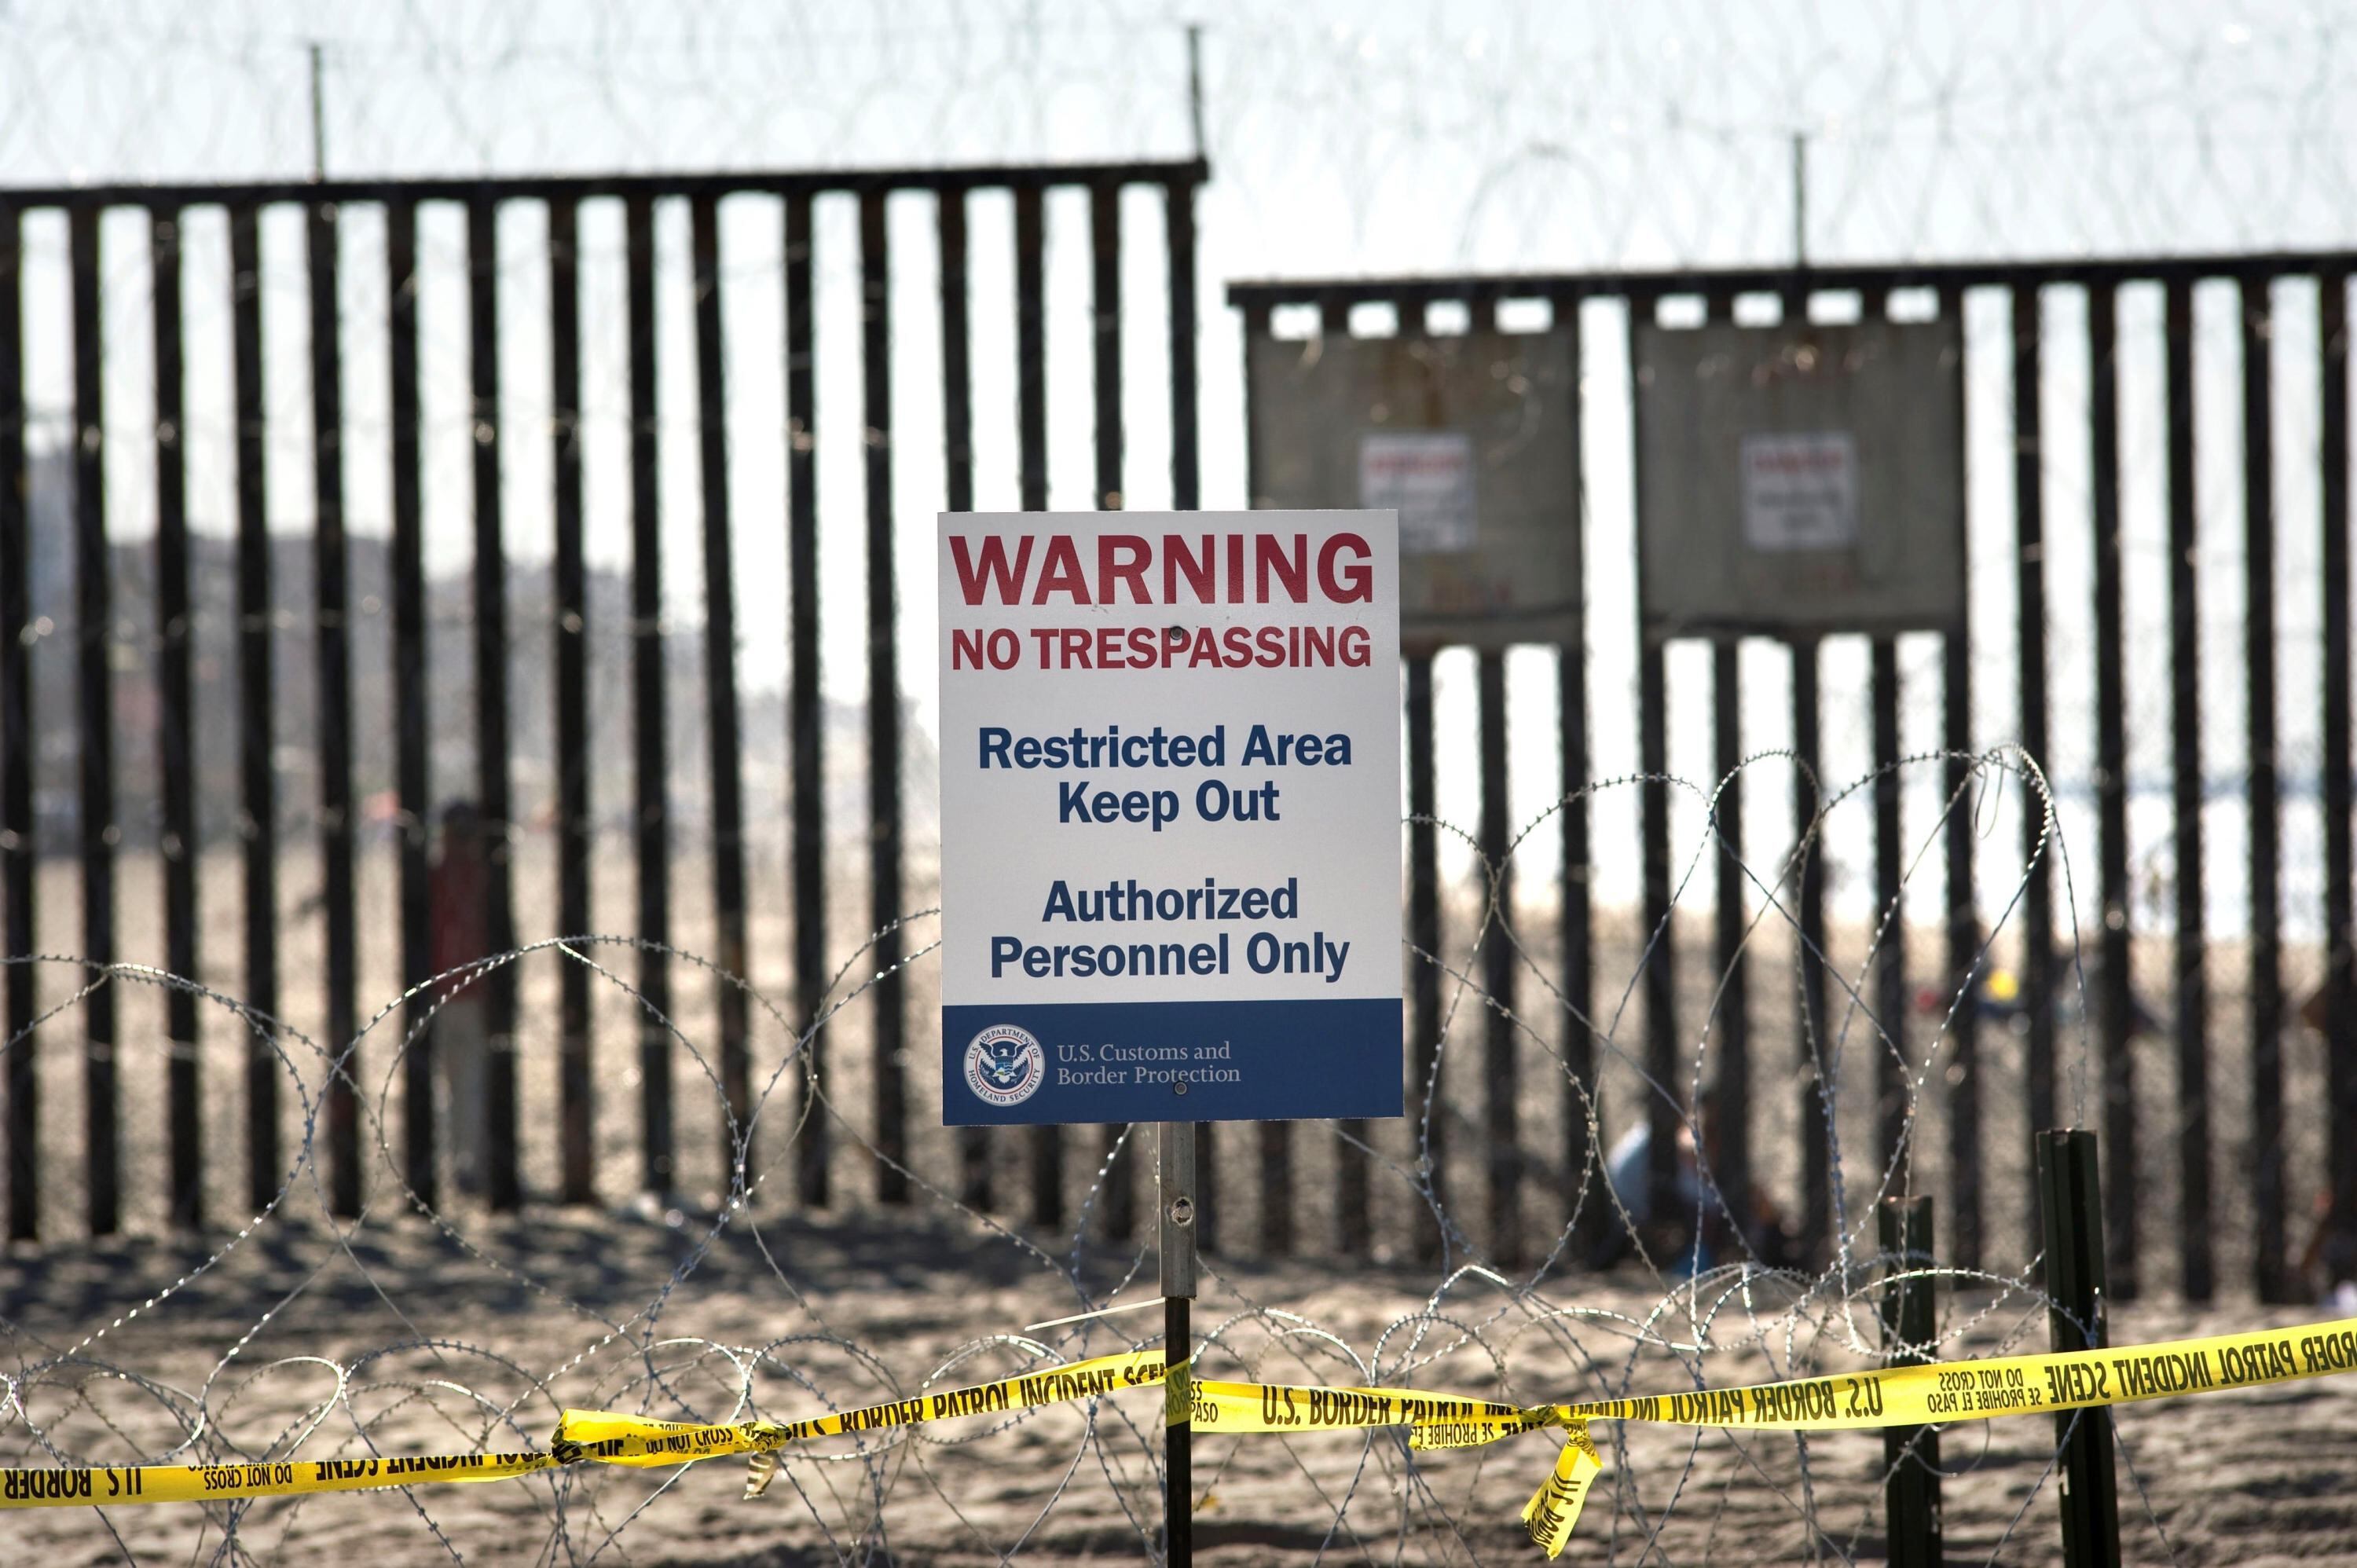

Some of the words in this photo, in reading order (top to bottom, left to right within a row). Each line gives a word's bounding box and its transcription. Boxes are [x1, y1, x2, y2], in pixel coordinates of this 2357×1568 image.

[949, 533, 1373, 605] WARNING
[952, 628, 1020, 670] NO
[1031, 625, 1371, 669] TRESPASSING
[979, 725, 1224, 768] Restricted
[1241, 725, 1351, 766] Area
[1059, 782, 1179, 831] Keep
[1196, 779, 1280, 822] Out
[1043, 877, 1297, 922] Authorized
[992, 933, 1228, 978] Personnel
[1247, 932, 1350, 982] Only
[969, 1046, 979, 1060] U.S.
[981, 1028, 1035, 1047] DEPARTMENT
[1032, 1048, 1040, 1060] OF
[1058, 1045, 1094, 1062] U.S.
[1099, 1043, 1188, 1061] Customs
[1194, 1041, 1230, 1059] and
[969, 1070, 1006, 1102] HOMELAND
[1010, 1069, 1039, 1101] SECURITY
[1058, 1068, 1127, 1085] Border
[1135, 1065, 1241, 1083] Protection
[933, 1383, 1009, 1419] PATROL
[1020, 1368, 1114, 1407] INCIDENT
[1263, 1385, 1300, 1425] U.S.
[1309, 1389, 1391, 1425] BORDER
[667, 1434, 691, 1451] NOT
[695, 1428, 733, 1446] CROSS
[1428, 1423, 1477, 1445] PROHIBE
[5, 1469, 91, 1499] BORDER
[204, 1470, 242, 1490] CROSS
[247, 1467, 270, 1487] NOT
[275, 1464, 292, 1484] DO
